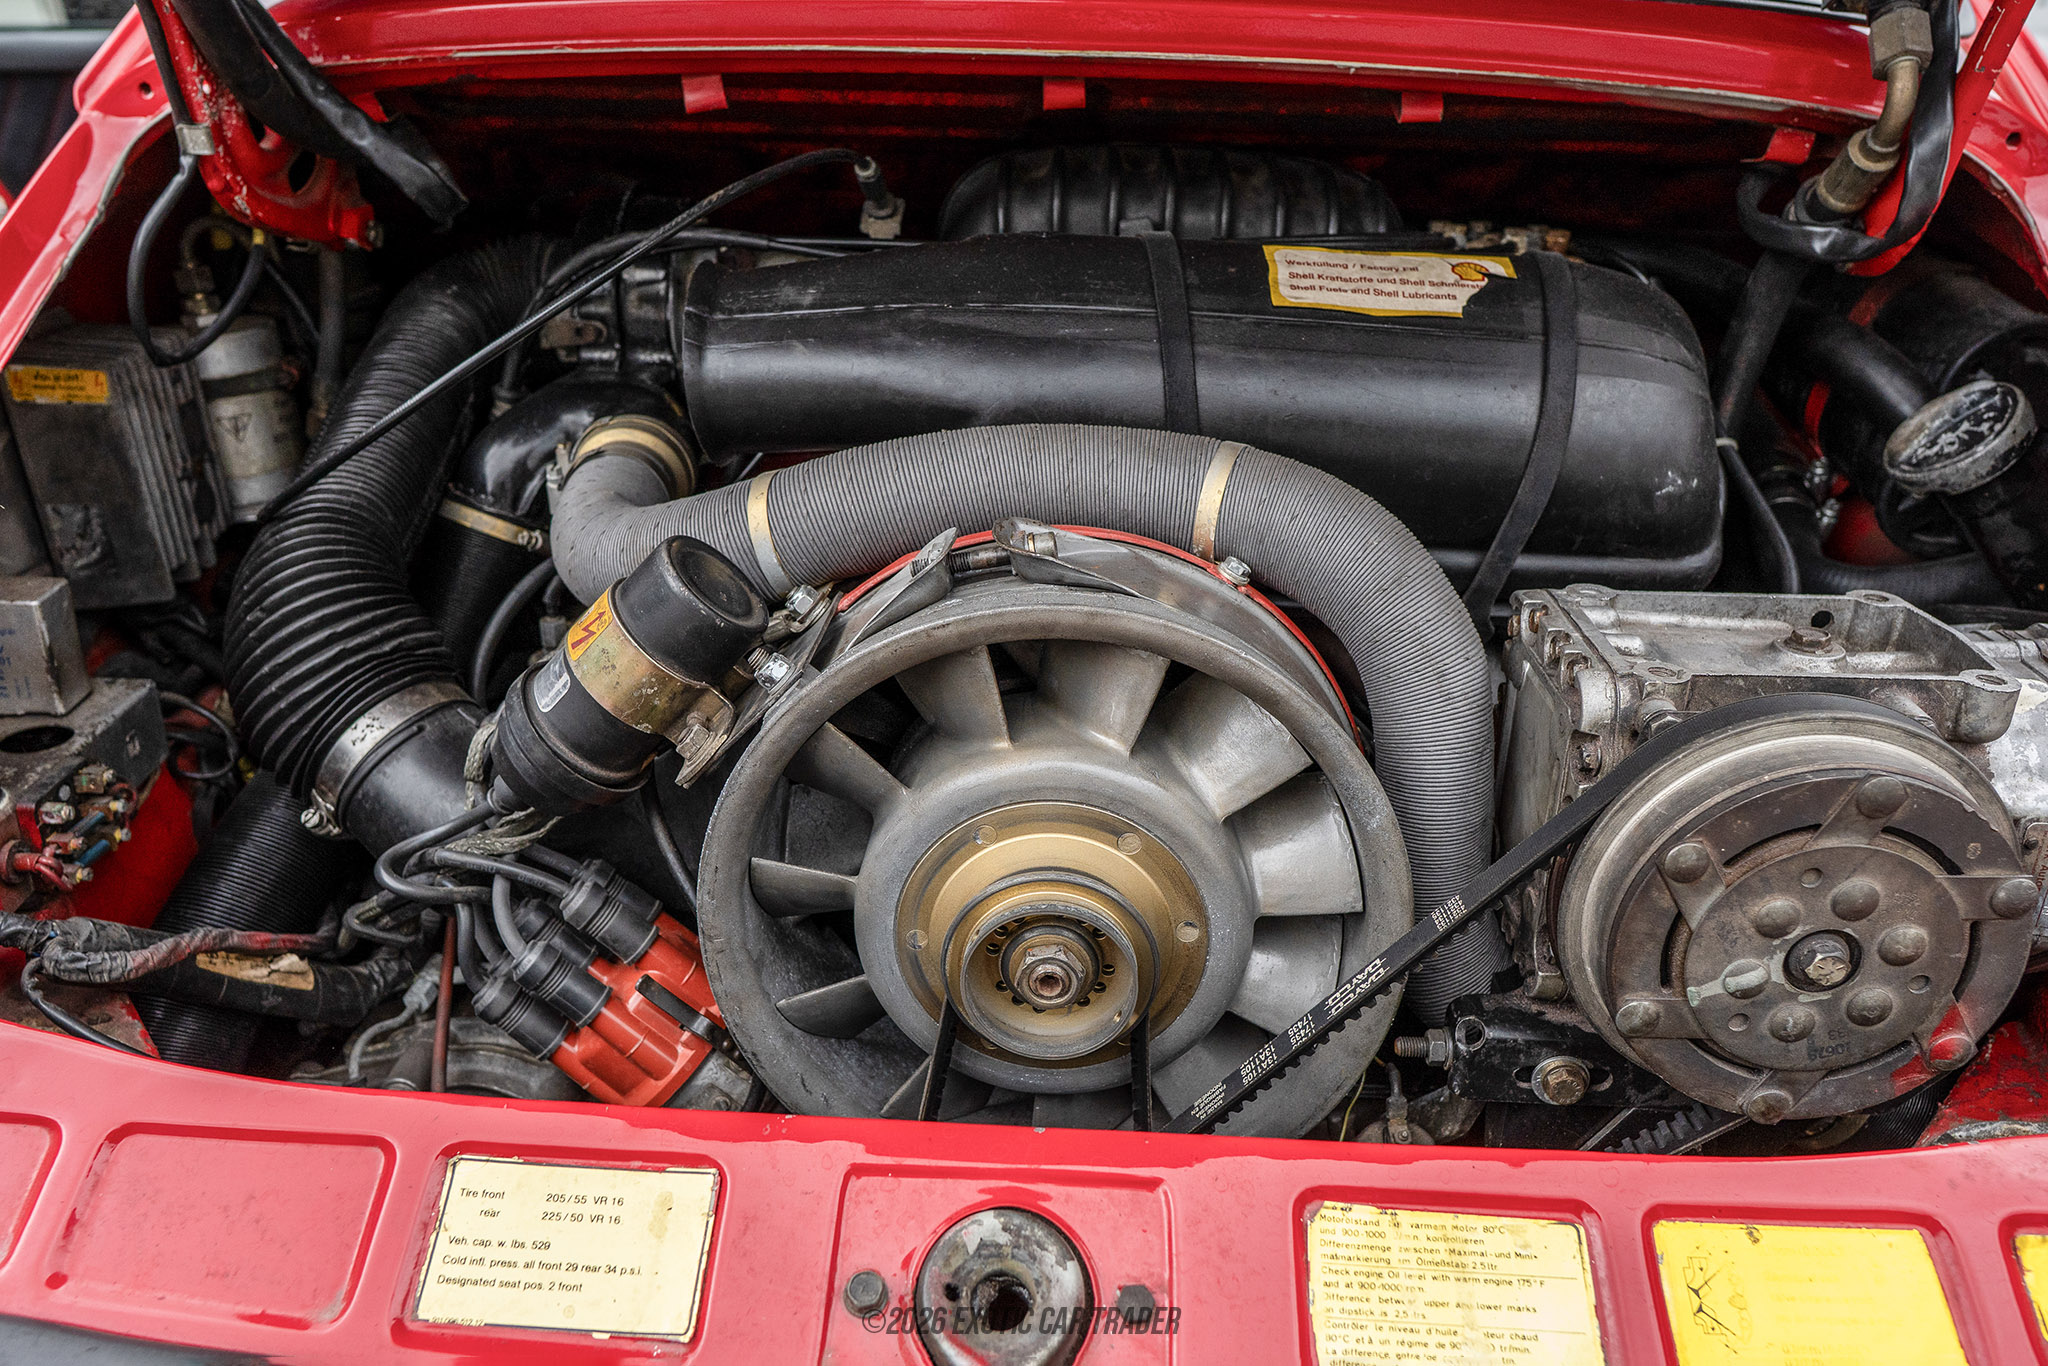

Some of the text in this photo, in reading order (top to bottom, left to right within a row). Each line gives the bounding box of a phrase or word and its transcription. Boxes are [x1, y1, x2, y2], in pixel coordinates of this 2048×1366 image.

[1360, 264, 1399, 272] Factory
[1288, 272, 1314, 280] Shell
[1318, 274, 1373, 284] Kraftstoffe
[1400, 278, 1426, 286] Shell
[1373, 288, 1399, 298] Shell
[1402, 290, 1457, 300] Lubricants
[1288, 1012, 1312, 1038] 17435
[1290, 1021, 1315, 1046] 17435
[1240, 1044, 1276, 1078] 13A1105
[1242, 1052, 1278, 1086] 13A1105
[460, 1188, 478, 1198] Tire
[482, 1190, 505, 1200] front
[593, 1196, 608, 1206] VR
[612, 1197, 624, 1206] 16
[480, 1209, 500, 1218] rear
[590, 1214, 604, 1224] VR
[608, 1216, 621, 1224] 16
[1482, 1225, 1506, 1234] 80°C
[448, 1236, 550, 1250] Veh. cap. w. lbs. 529
[1320, 1239, 1392, 1252] Differenzmenge
[1427, 1234, 1484, 1244] kontrollieren
[442, 1255, 642, 1276] Cold infl. press. all front 29 rear 34 p.s.i.
[437, 1274, 582, 1292] Designated seat pos. 2 front
[1322, 1266, 1350, 1276] Check
[1354, 1270, 1384, 1279] engine
[1432, 1272, 1450, 1281] with
[1484, 1278, 1513, 1286] engine
[1339, 1306, 1374, 1316] dipstick
[1476, 1302, 1502, 1311] lower
[1507, 1304, 1537, 1313] marks
[1324, 1320, 1368, 1331] Contrôler
[1375, 1322, 1384, 1331] le
[1389, 1325, 1420, 1334] niveau
[1426, 1328, 1458, 1336] d'huile
[1510, 1333, 1538, 1342] chaud
[1396, 1338, 1429, 1348] régime
[1436, 1340, 1446, 1348] de
